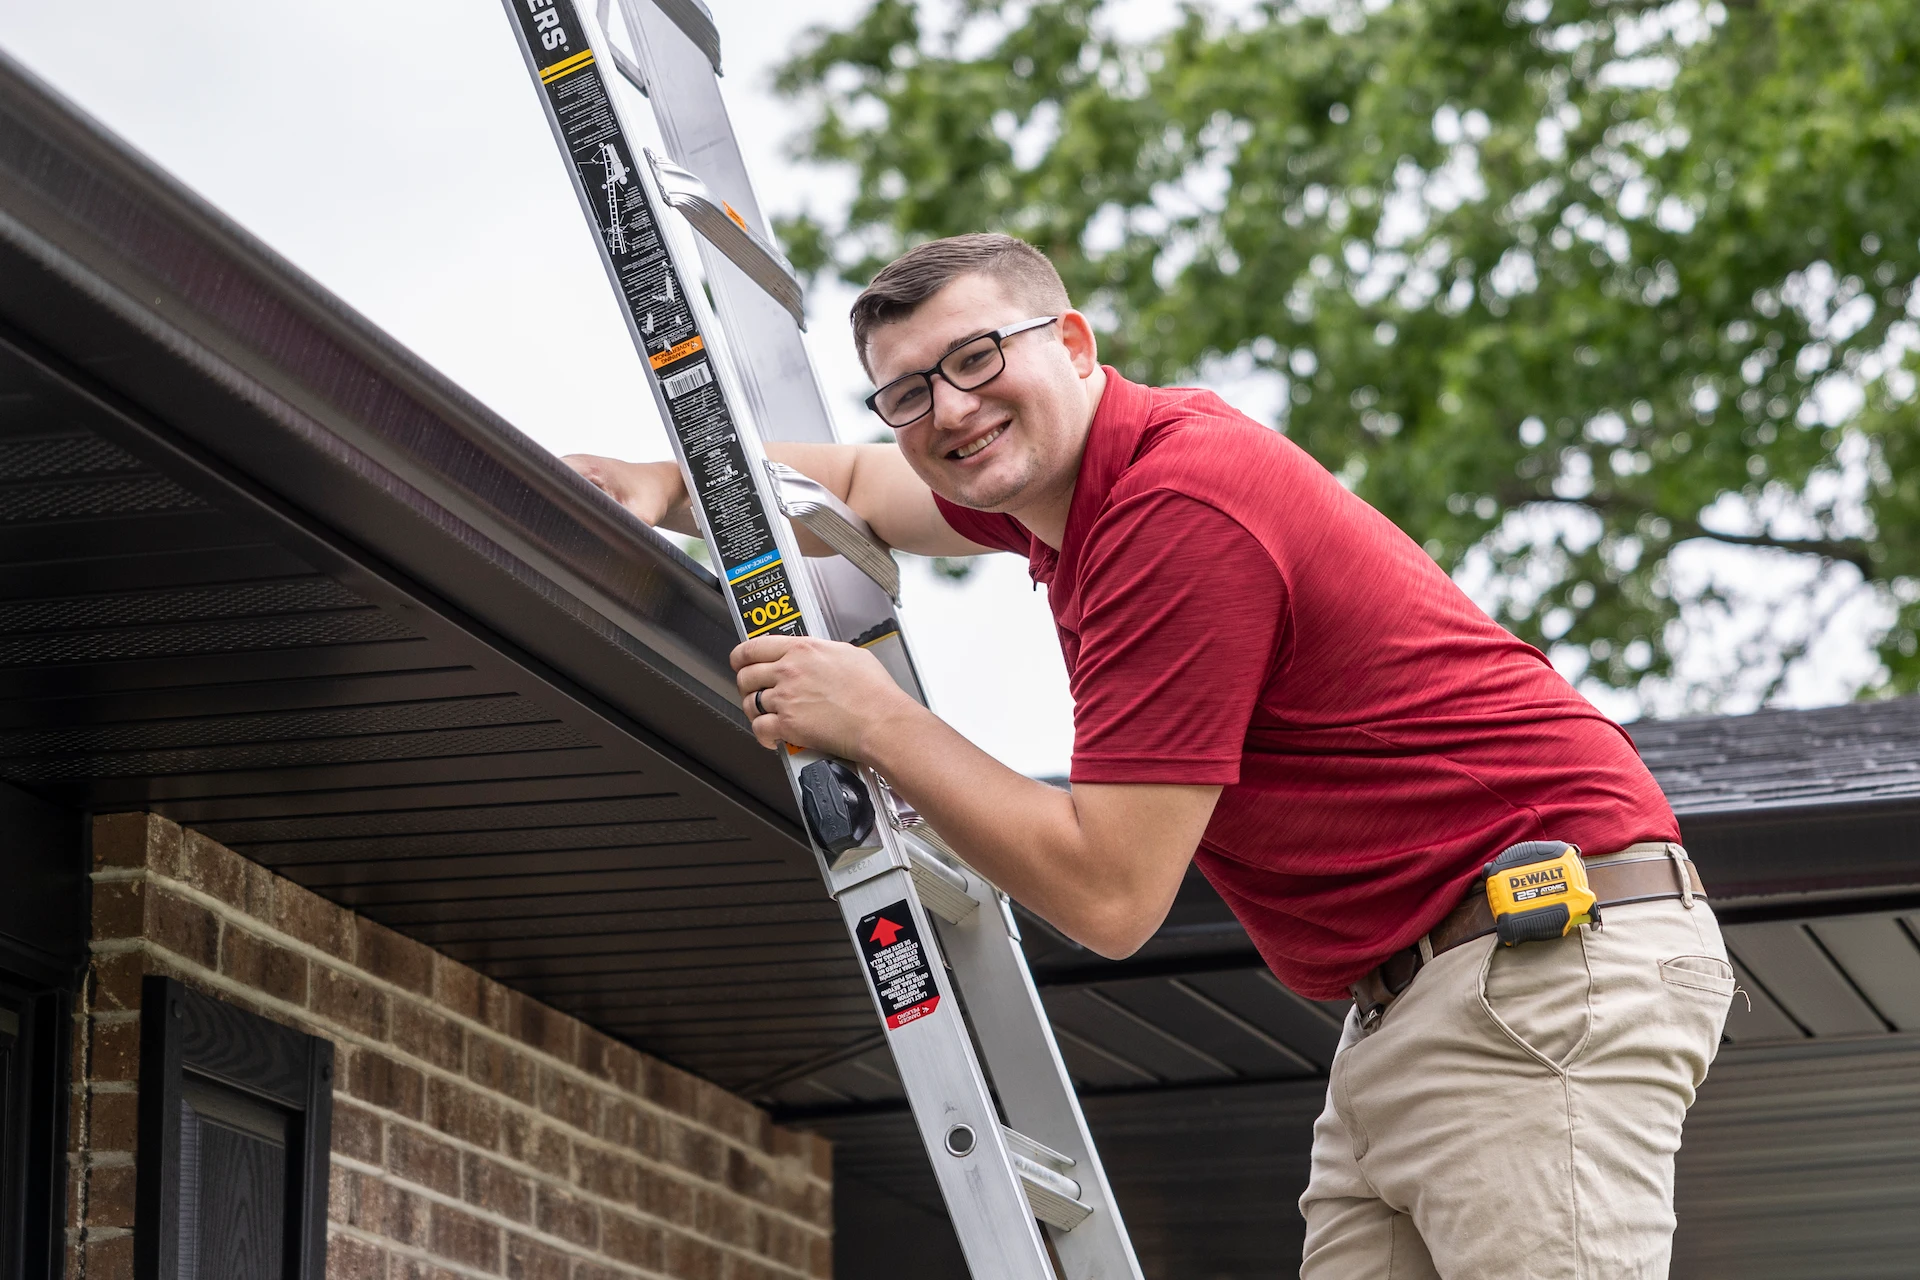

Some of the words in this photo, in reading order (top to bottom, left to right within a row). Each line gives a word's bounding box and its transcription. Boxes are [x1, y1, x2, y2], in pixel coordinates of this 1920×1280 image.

[653, 341, 689, 361] ADVERTENCIA
[660, 349, 686, 364] WARNING
[757, 570, 782, 587] TYPE
[741, 581, 784, 605] CAPACITY
[744, 582, 756, 592] IA
[762, 587, 787, 602] LOAD
[751, 595, 794, 626] 300
[1540, 883, 1564, 892] ATOMIC
[896, 988, 919, 1002] POSITION
[913, 990, 927, 1001] LAST
[892, 996, 914, 1010] LOCKING
[896, 1006, 920, 1020] PELIGRO
[898, 1011, 920, 1024] DANGER
